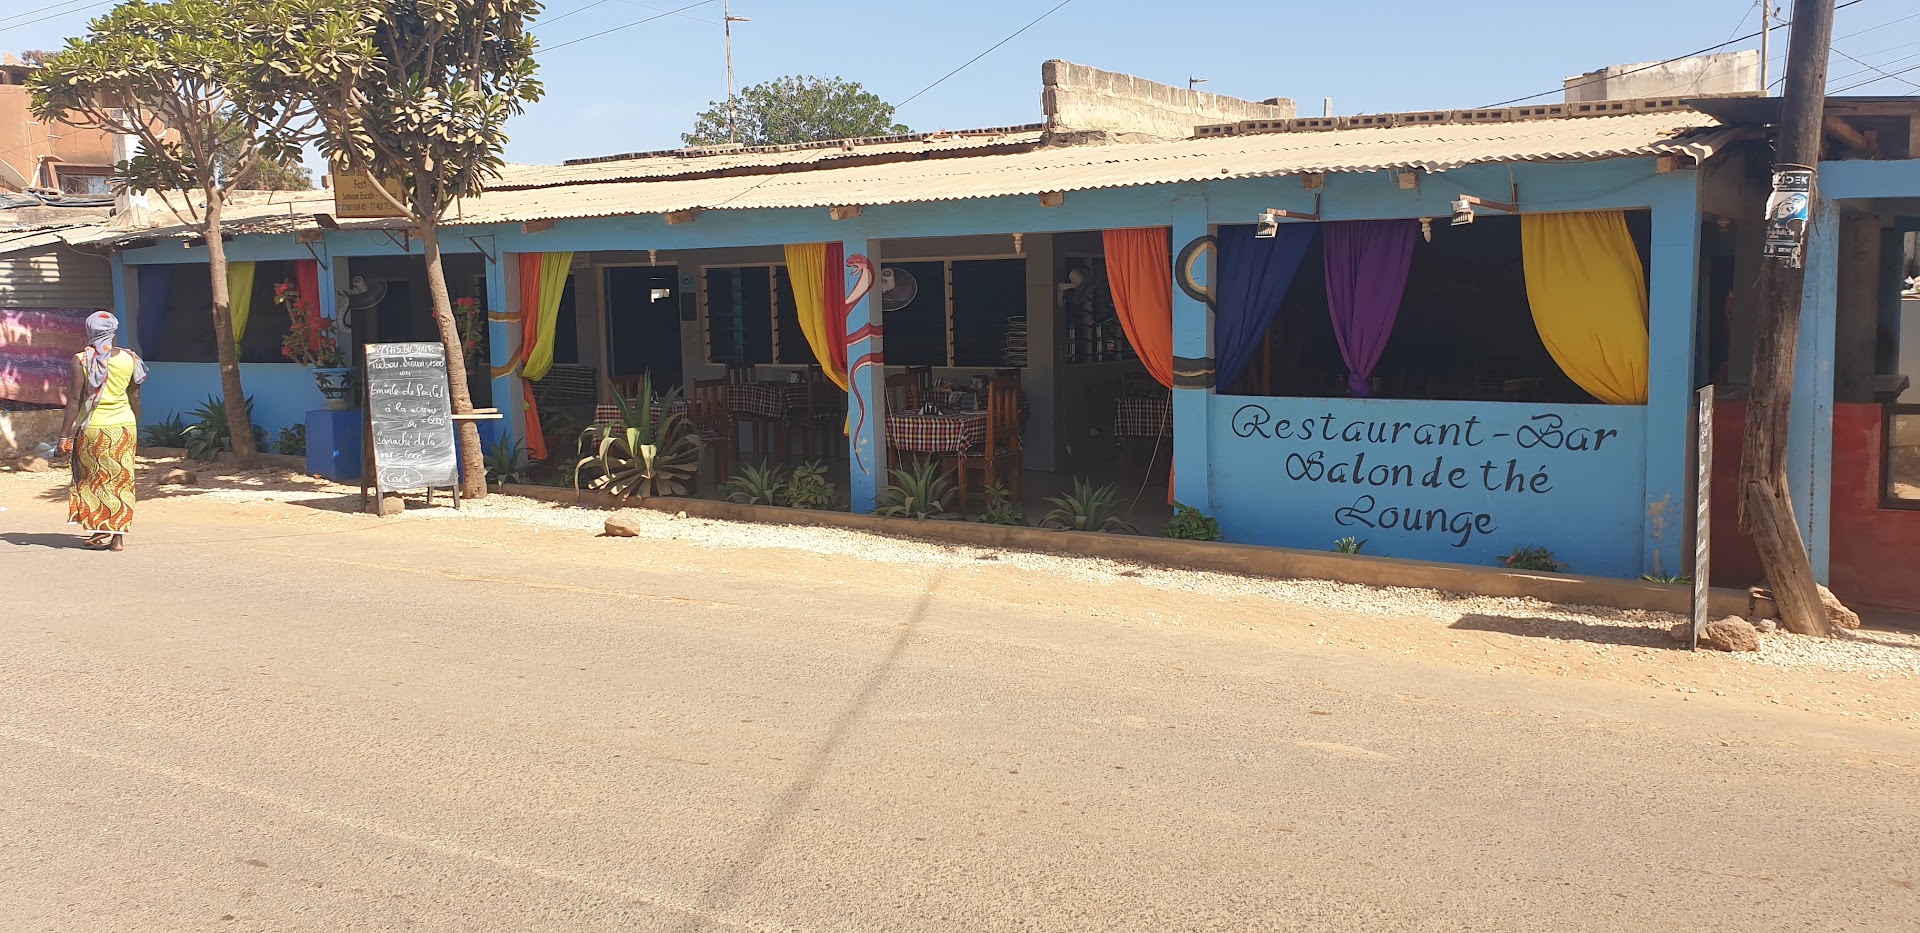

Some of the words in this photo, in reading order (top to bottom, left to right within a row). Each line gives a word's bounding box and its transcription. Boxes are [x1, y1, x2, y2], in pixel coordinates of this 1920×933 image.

[402, 381, 415, 395] de
[394, 402, 406, 412] la
[414, 433, 425, 446] de
[1516, 413, 1618, 452] Bar
[387, 469, 411, 482] Carte
[1285, 450, 1414, 487] Salon
[1422, 456, 1466, 489] de
[1480, 458, 1554, 494] thé
[1334, 494, 1496, 548] Lounge
